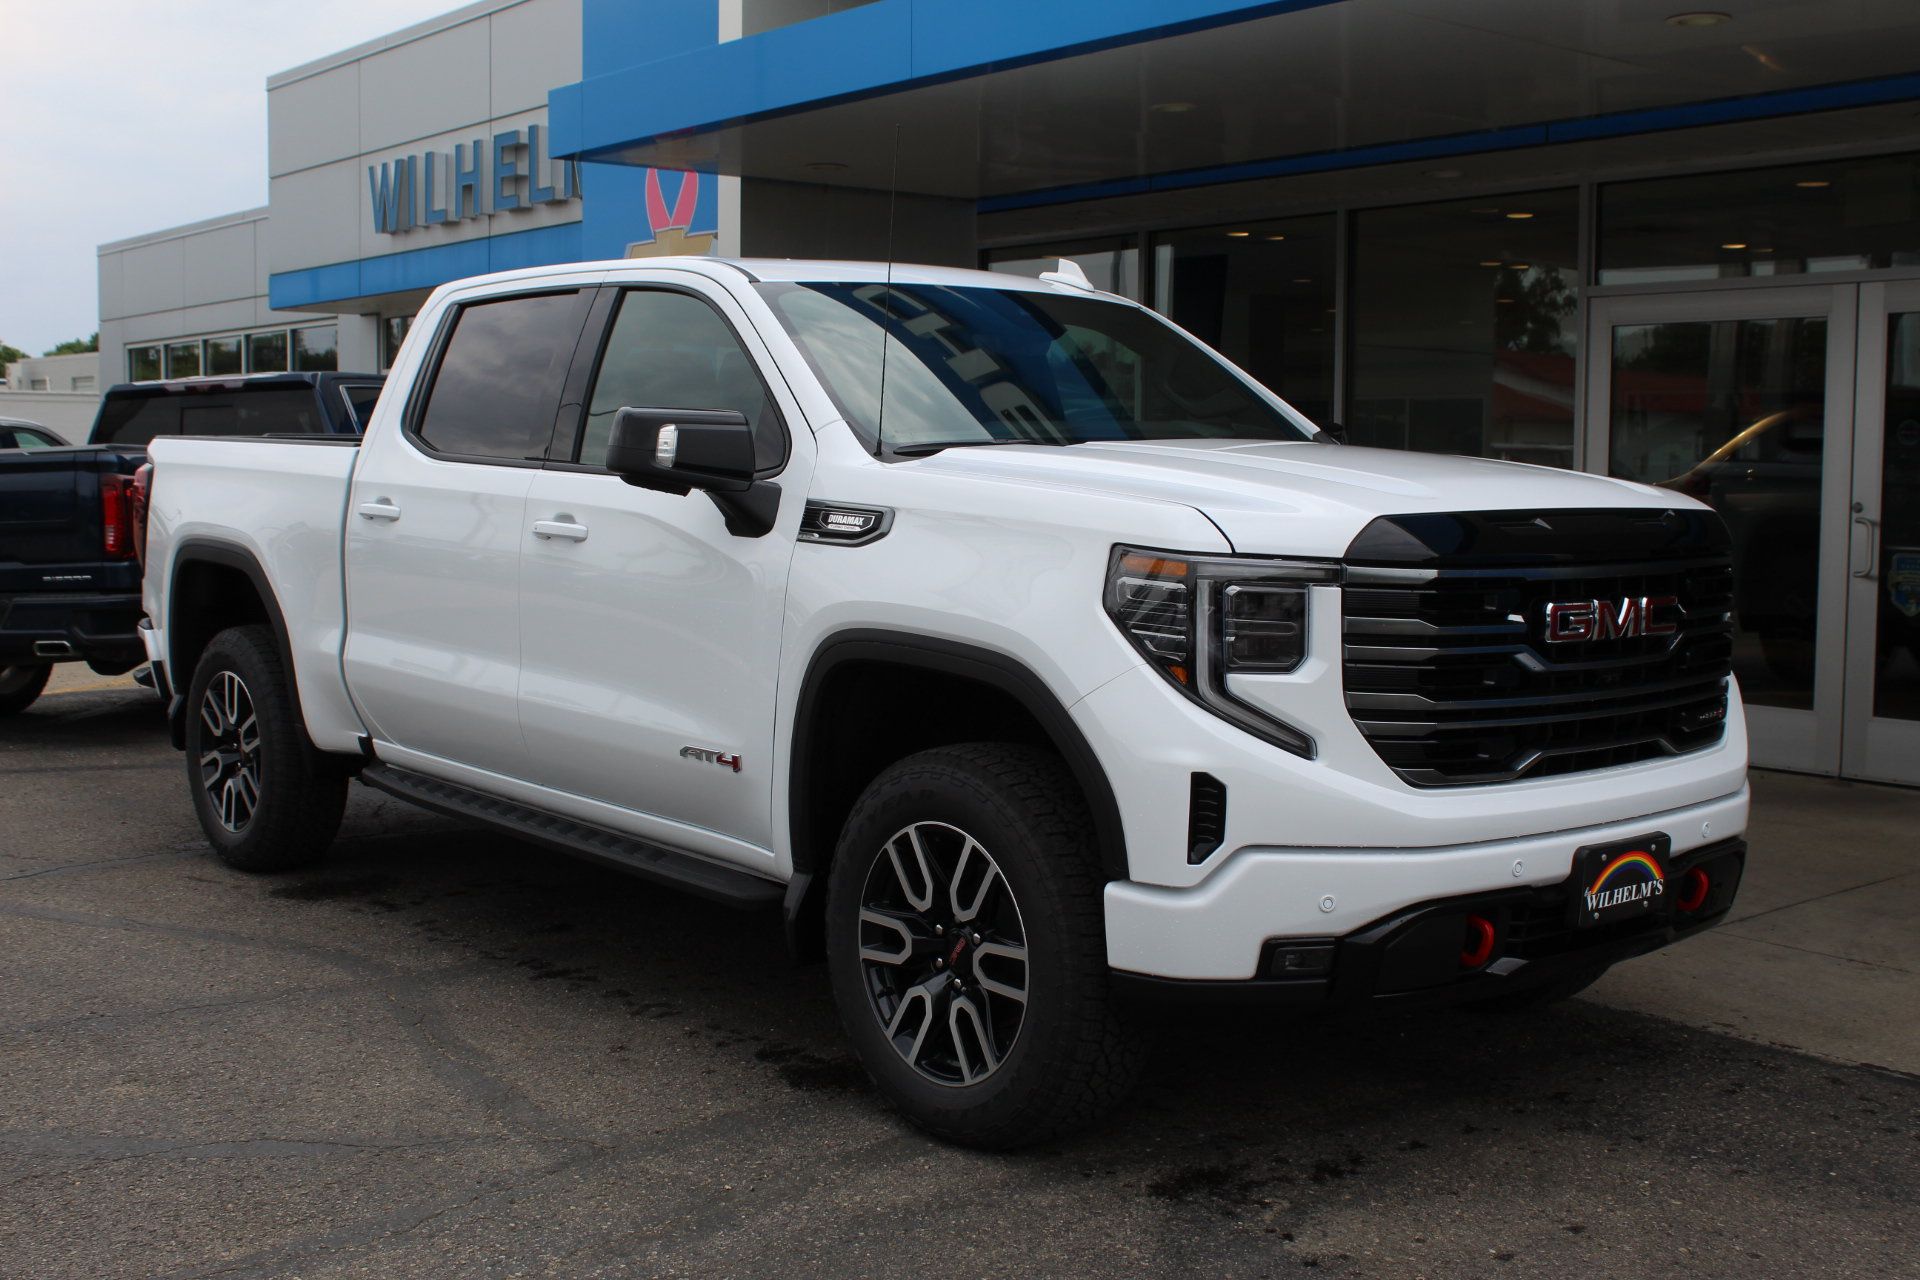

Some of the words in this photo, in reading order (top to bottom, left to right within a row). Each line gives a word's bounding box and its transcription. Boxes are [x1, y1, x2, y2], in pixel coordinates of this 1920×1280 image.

[368, 123, 582, 234] WILHEL
[828, 514, 864, 525] DURAMAX
[1545, 596, 1678, 642] GMC
[679, 744, 743, 773] AT4
[1586, 878, 1664, 911] WILHELM'S
